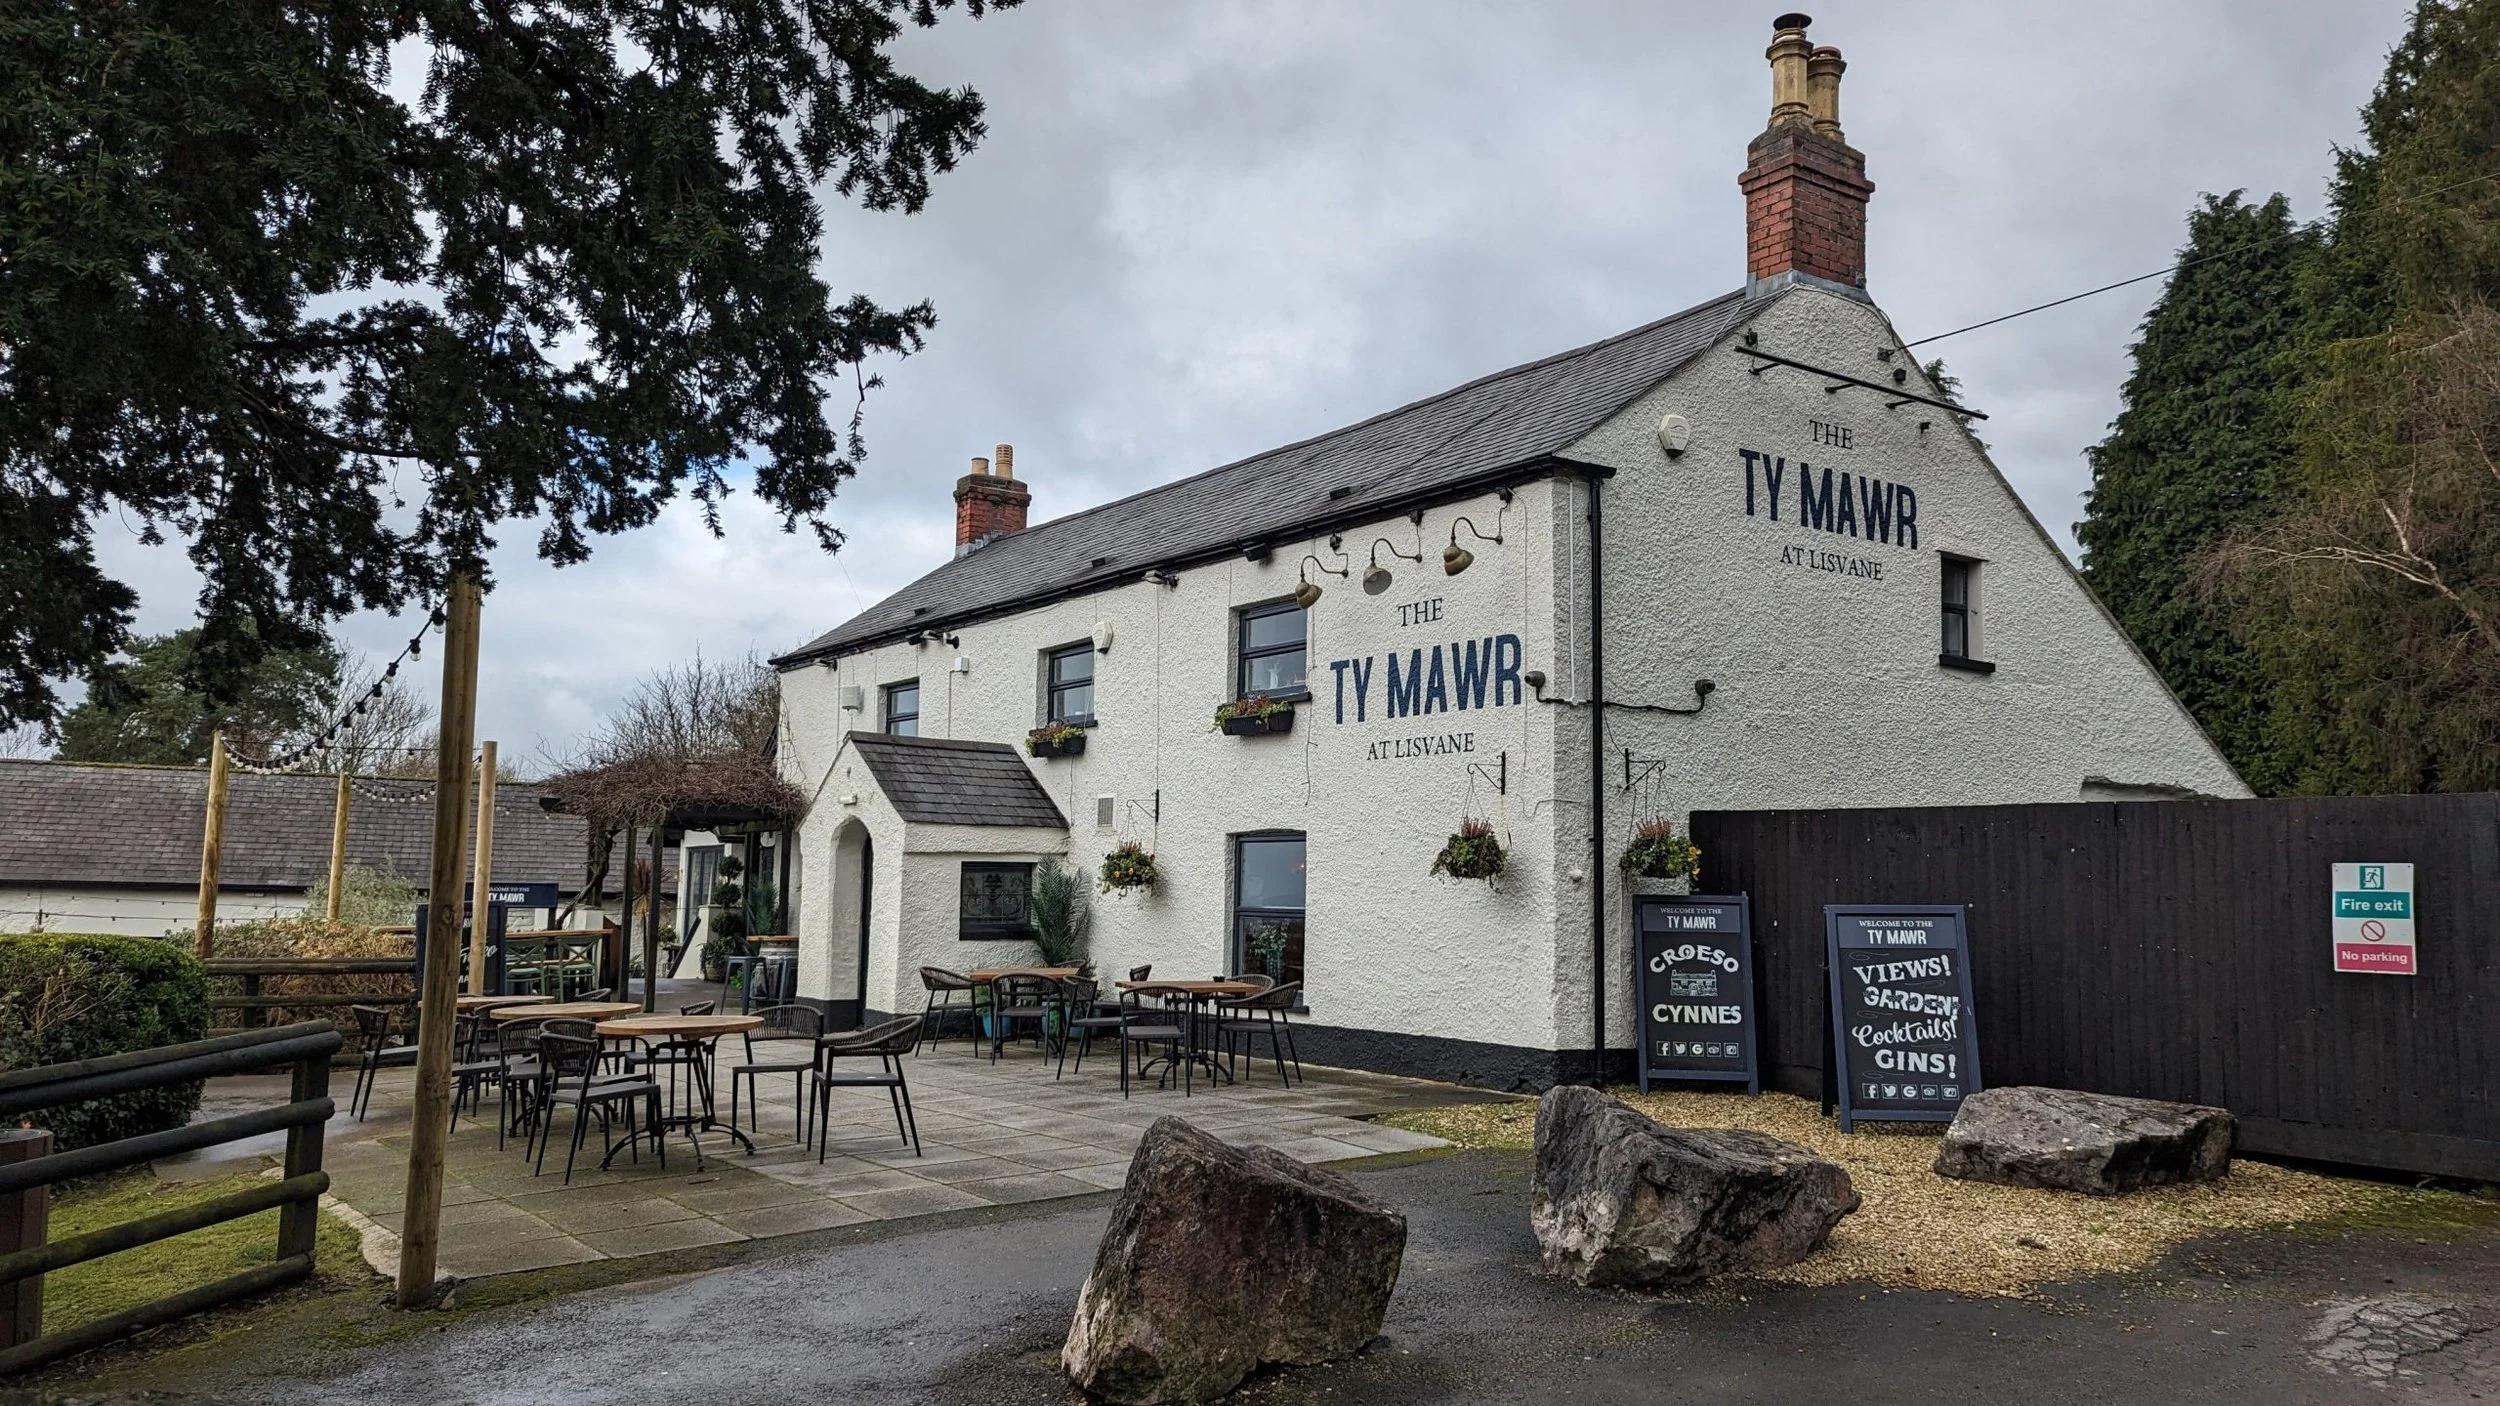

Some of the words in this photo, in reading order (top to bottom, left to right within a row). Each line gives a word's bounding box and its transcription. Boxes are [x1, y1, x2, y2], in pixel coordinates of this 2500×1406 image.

[1809, 420, 1853, 449] THE
[1739, 448, 1785, 521] TY
[1801, 462, 1918, 550] MAWR
[1780, 545, 1805, 566] AT
[1809, 548, 1883, 580] LISVANE
[1398, 598, 1444, 627] THE
[1330, 656, 1374, 724] TY
[1387, 633, 1522, 718] MAWR
[1366, 740, 1394, 761] AT
[1395, 733, 1475, 759] LISVANE
[499, 893, 525, 902] MAWR
[2341, 898, 2370, 911] Fire
[2374, 899, 2403, 911] exit
[1667, 915, 1680, 928] TY
[1683, 916, 1716, 929] MAWR
[1915, 920, 1933, 928] THE
[1867, 930, 1882, 945] TY
[1886, 930, 1927, 945] MAWR
[1650, 944, 1739, 973] CROESO
[1853, 954, 1952, 985] VIEWS!
[2342, 950, 2359, 960] No
[2362, 952, 2408, 965] parking
[1652, 1003, 1742, 1025] CYNNES
[1863, 986, 1960, 1020] GARDEN!
[1851, 1018, 1957, 1047] Cocktails!
[1874, 1049, 1956, 1079] GINS!
